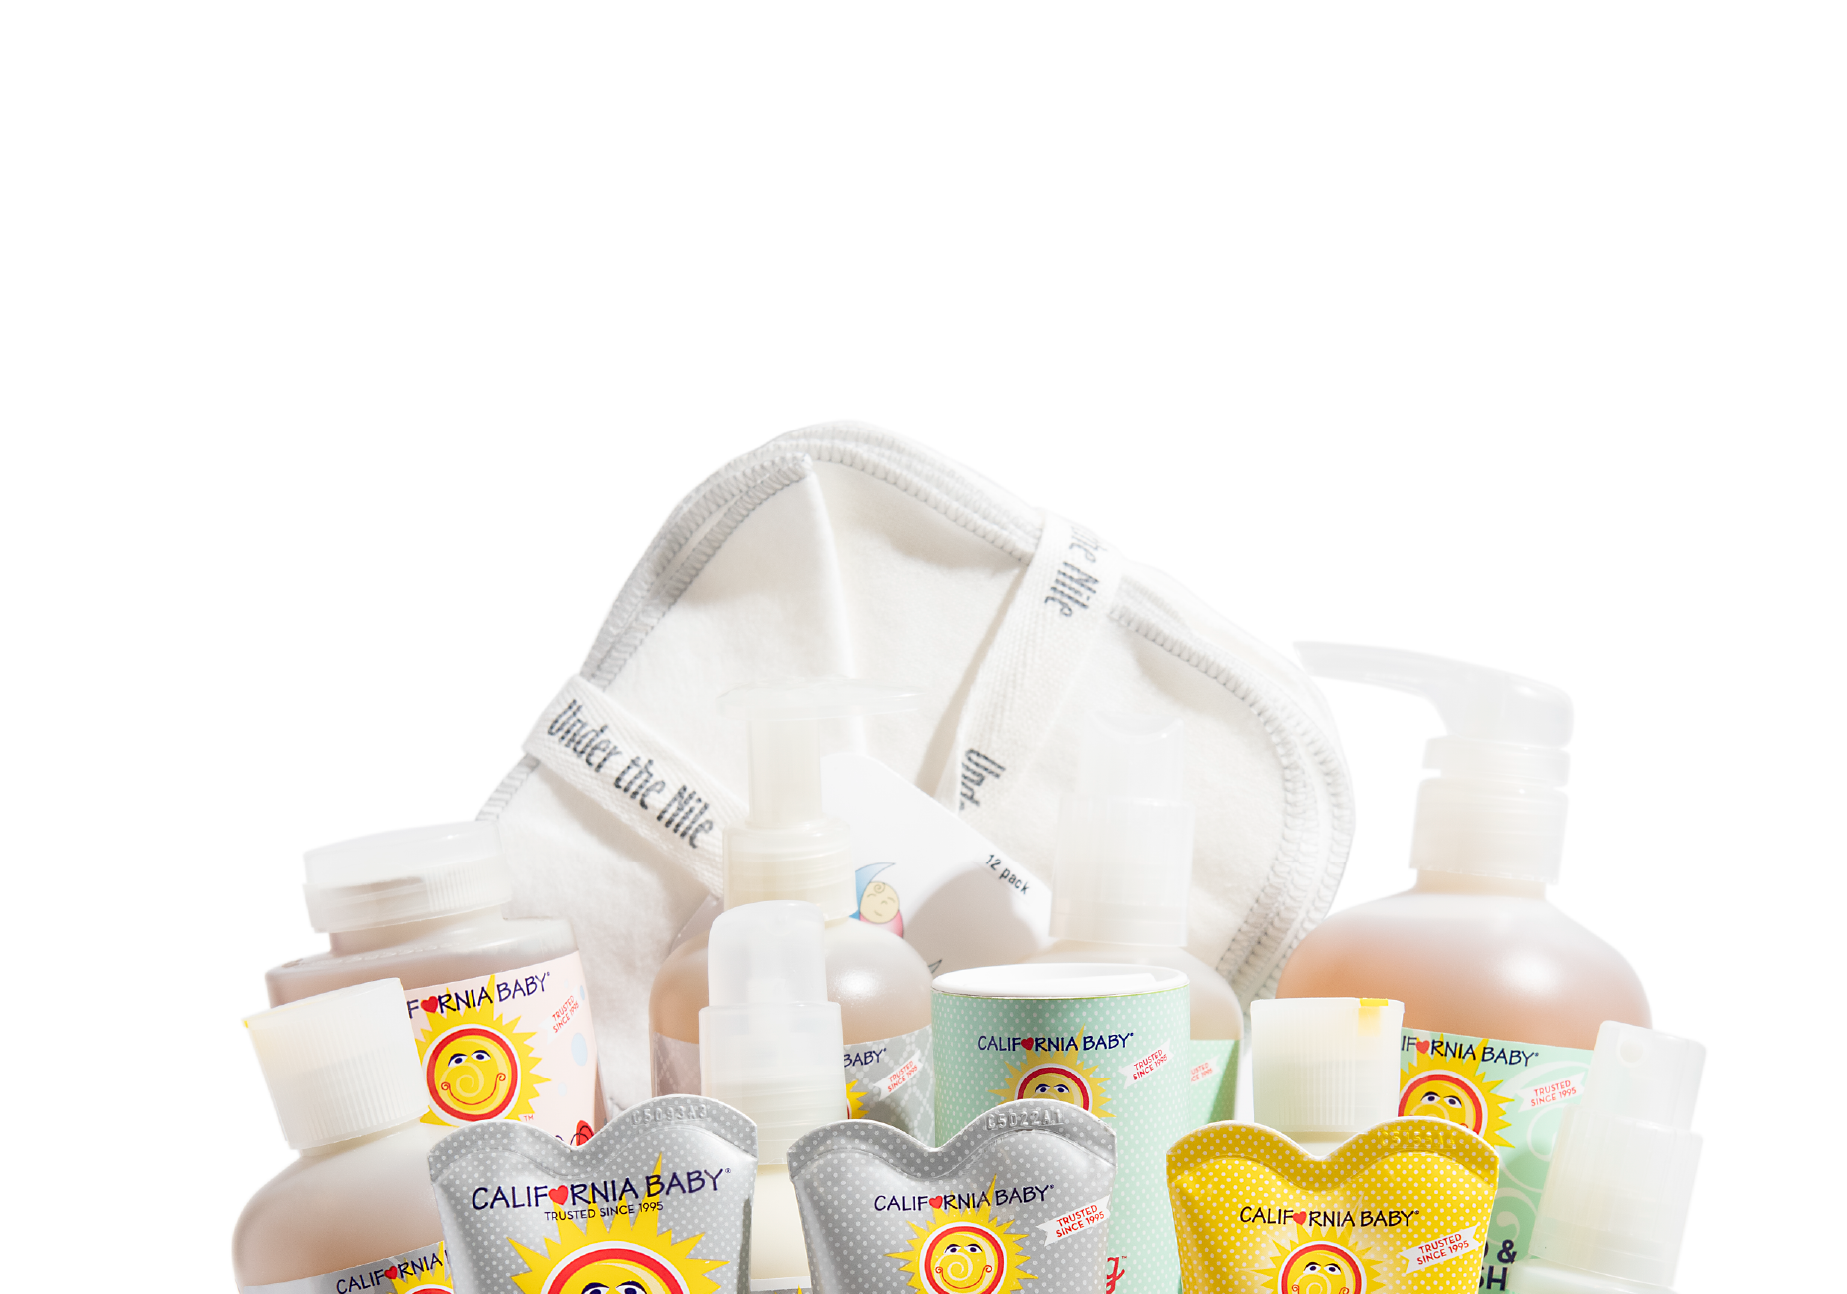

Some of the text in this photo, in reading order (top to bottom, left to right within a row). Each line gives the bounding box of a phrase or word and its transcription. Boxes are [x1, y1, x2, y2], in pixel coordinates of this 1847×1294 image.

[1044, 561, 1100, 617] Nile
[547, 698, 713, 849] Under the Nile
[959, 748, 1006, 811] Und
[986, 854, 1029, 895] 12 pack
[552, 995, 575, 1022] TRUSTED
[552, 1012, 571, 1034] SINCE
[1134, 1049, 1164, 1071] TRUSTED
[1132, 1065, 1155, 1081] SINCE
[1531, 1086, 1578, 1107] SINCE 1995
[1534, 1079, 1571, 1097] TRUSTED
[544, 1201, 664, 1222] TRUSTED SINCE 1995
[1056, 1204, 1098, 1228] TRUSTED
[1055, 1211, 1105, 1239] SINCE 1995
[1416, 1249, 1447, 1266] SINCE
[1447, 1239, 1470, 1254] 1995
[1418, 1233, 1462, 1255] TRUSTED
